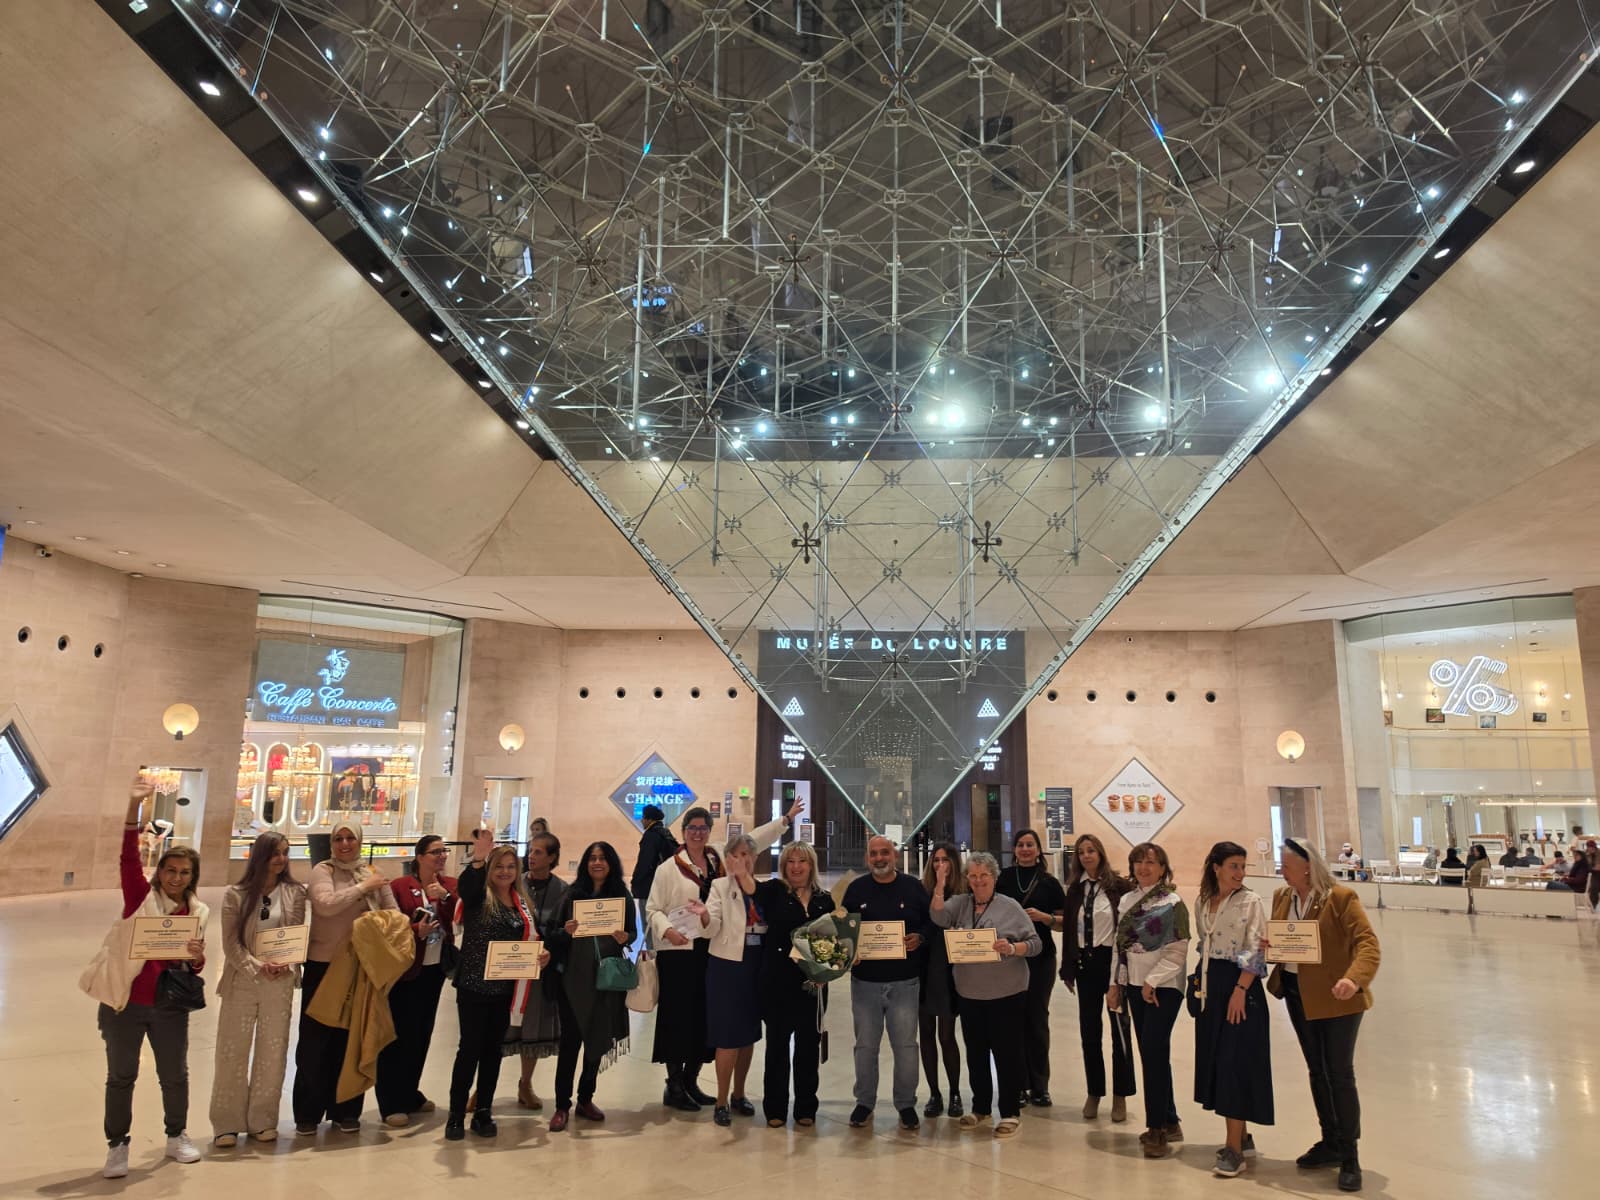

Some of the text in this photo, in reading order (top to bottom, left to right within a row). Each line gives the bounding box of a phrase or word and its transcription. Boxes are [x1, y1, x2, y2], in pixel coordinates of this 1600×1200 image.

[913, 638, 1007, 650] LOUVRE
[319, 687, 398, 712] Concerto
[625, 794, 684, 805] CHANGE
